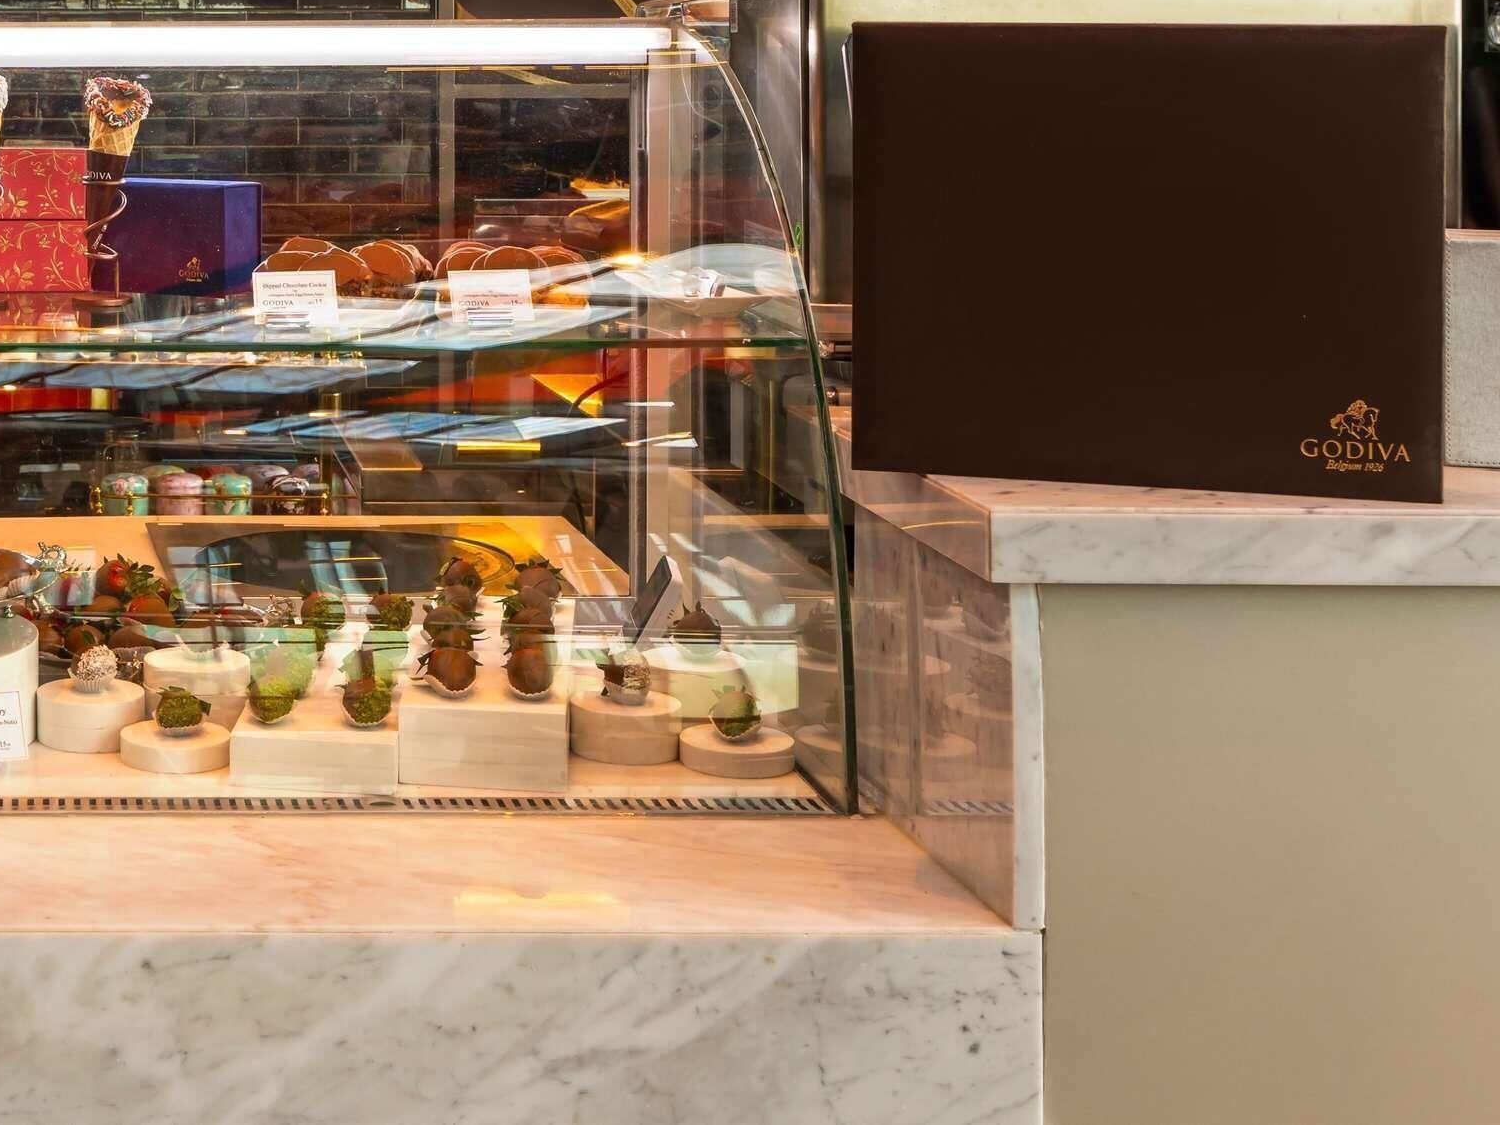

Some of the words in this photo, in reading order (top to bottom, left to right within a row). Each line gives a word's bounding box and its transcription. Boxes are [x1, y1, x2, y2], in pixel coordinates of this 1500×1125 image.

[1300, 438, 1411, 462] GODIVA
[1326, 460, 1362, 472] Belgium
[1364, 462, 1385, 472] 1926
